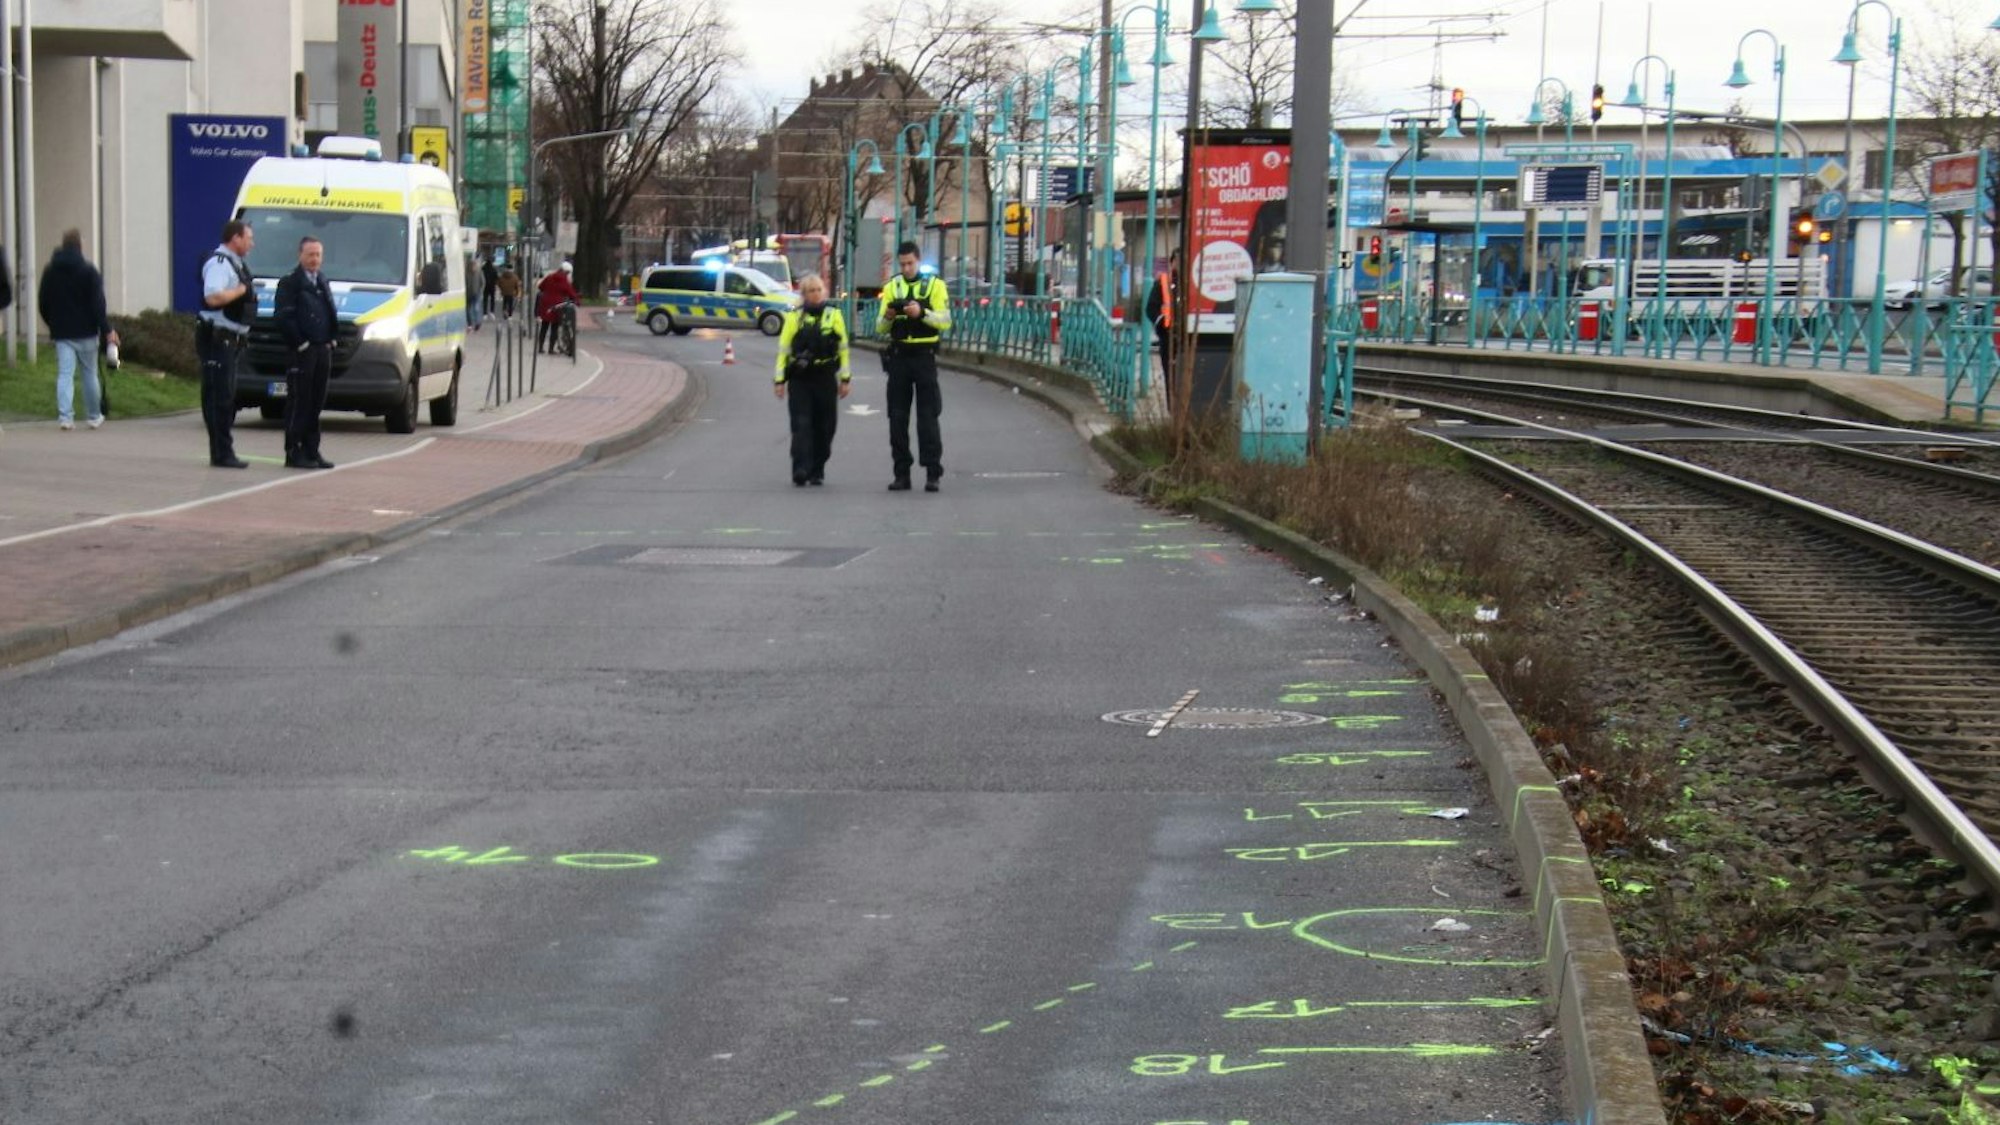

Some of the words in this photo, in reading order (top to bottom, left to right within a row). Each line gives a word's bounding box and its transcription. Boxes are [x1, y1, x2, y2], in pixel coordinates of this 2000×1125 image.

[467, 0, 485, 20] Re
[467, 26, 485, 92] 1AVista
[360, 23, 380, 136] pus·Deutz
[188, 122, 269, 138] VOLVO
[190, 147, 212, 157] Volvo
[214, 147, 229, 157] Car
[230, 147, 267, 158] Germany
[1198, 161, 1251, 189] TSCHÖ
[262, 195, 385, 210] UNFALLAUFNAHME
[1129, 1053, 1288, 1076] 18
